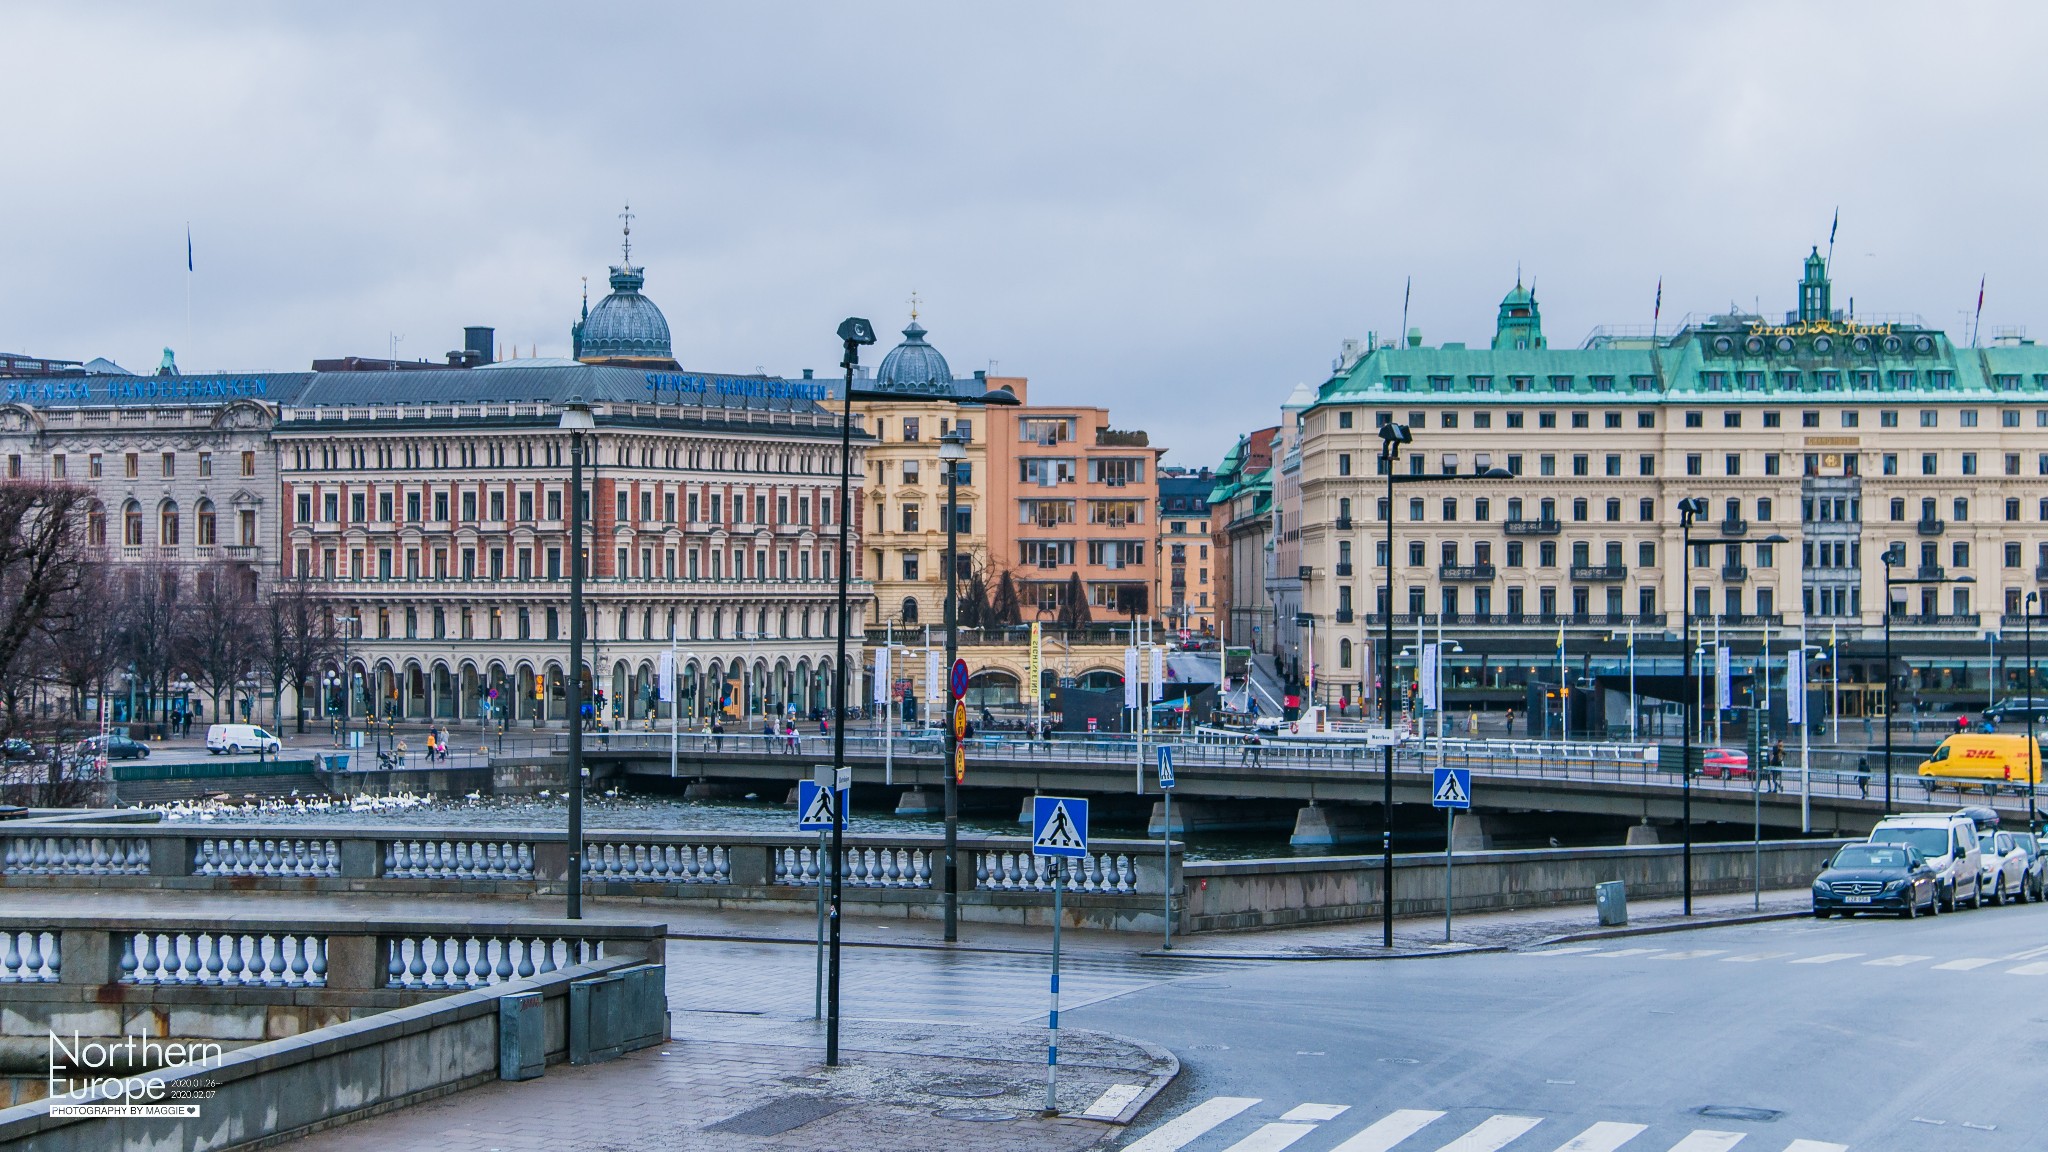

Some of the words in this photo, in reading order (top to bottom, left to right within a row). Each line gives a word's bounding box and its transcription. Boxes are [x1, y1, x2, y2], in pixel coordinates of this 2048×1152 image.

[1750, 320, 1807, 335] Grand
[7, 383, 91, 400] SVENSKA
[108, 379, 268, 399] HANDELSBANKEN
[645, 373, 707, 394] SVENSKA
[716, 377, 826, 400] HANDELSBANKEN
[1965, 750, 1996, 758] DHL
